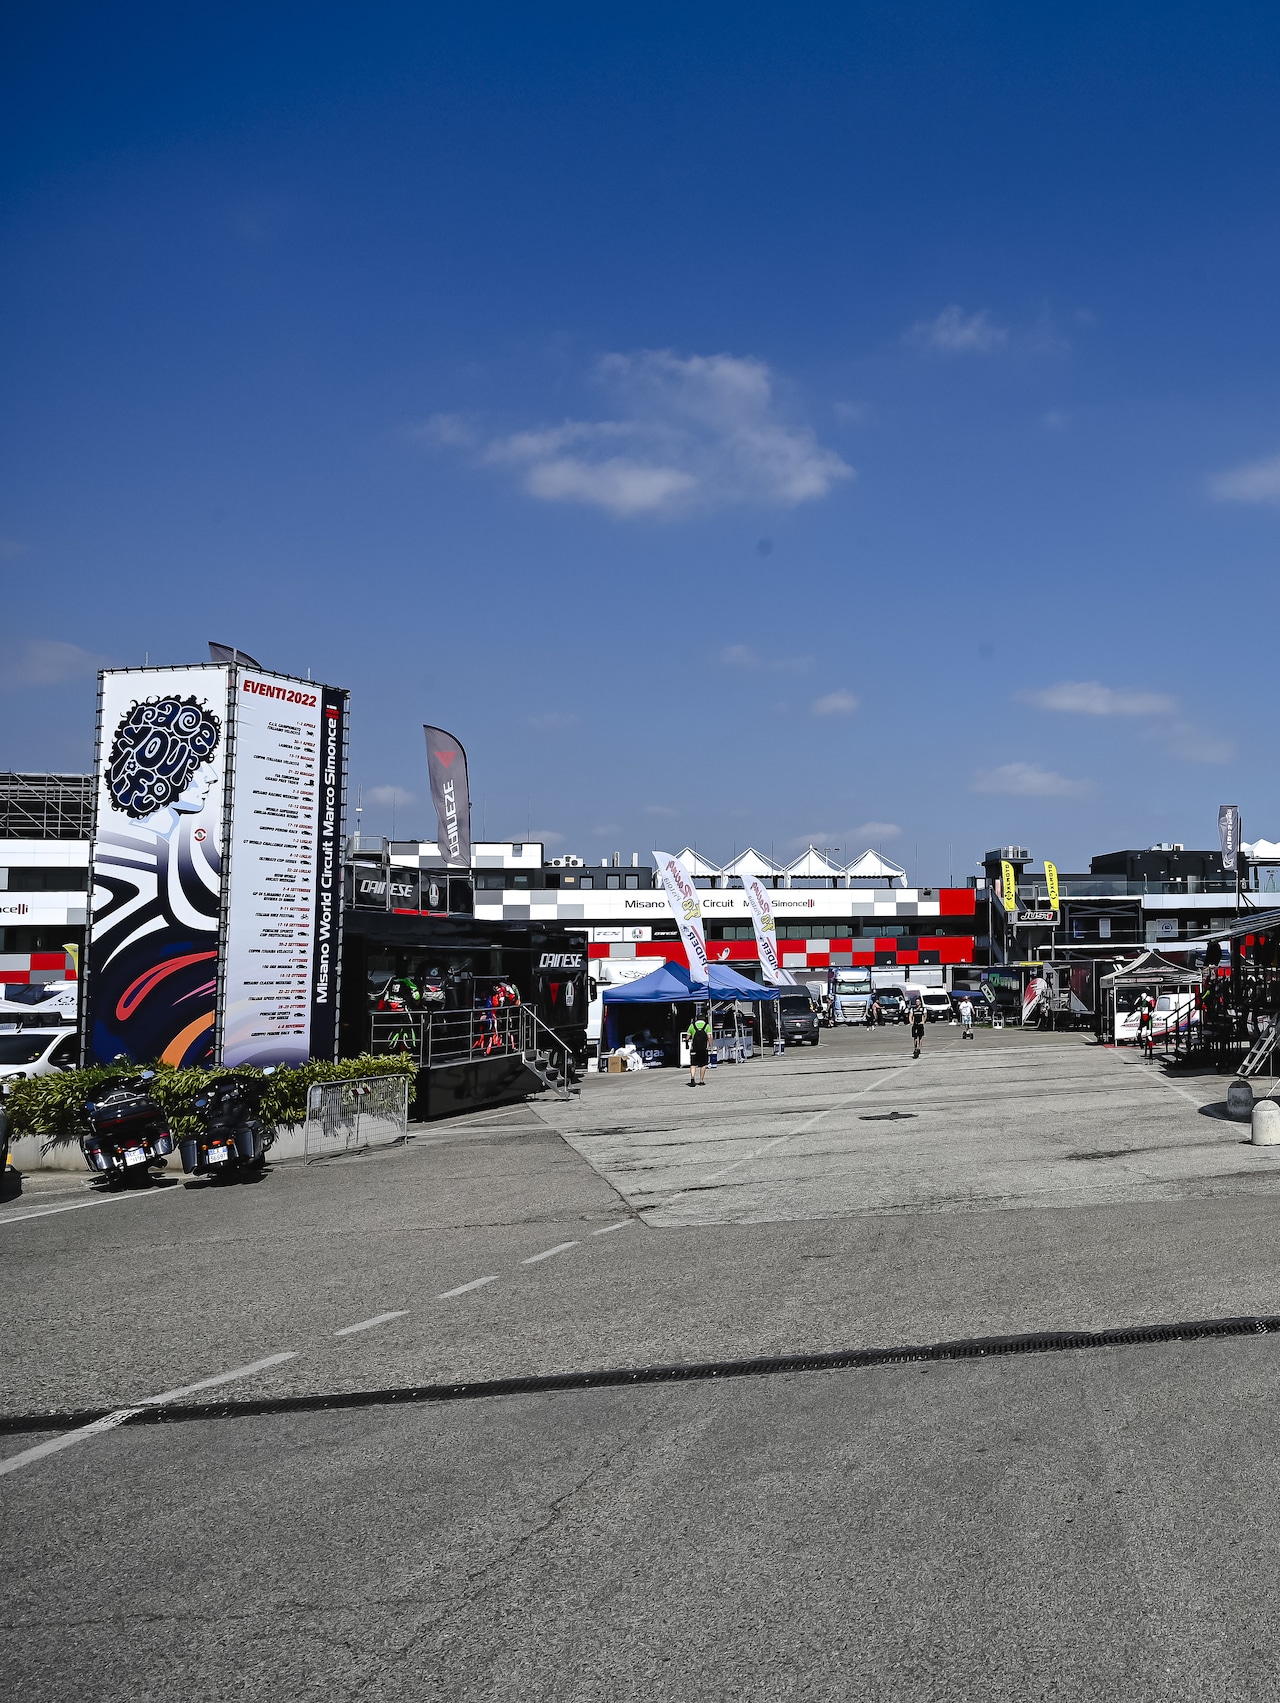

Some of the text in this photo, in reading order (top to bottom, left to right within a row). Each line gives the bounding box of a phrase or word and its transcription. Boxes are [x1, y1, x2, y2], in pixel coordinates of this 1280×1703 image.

[316, 704, 339, 1004] Misano World Circuit Marco Simoncelli
[0, 904, 28, 915] celli
[625, 900, 666, 909] Misano
[702, 899, 734, 908] Circuit
[771, 899, 815, 908] Simoncelli
[539, 953, 583, 968] DAINESE
